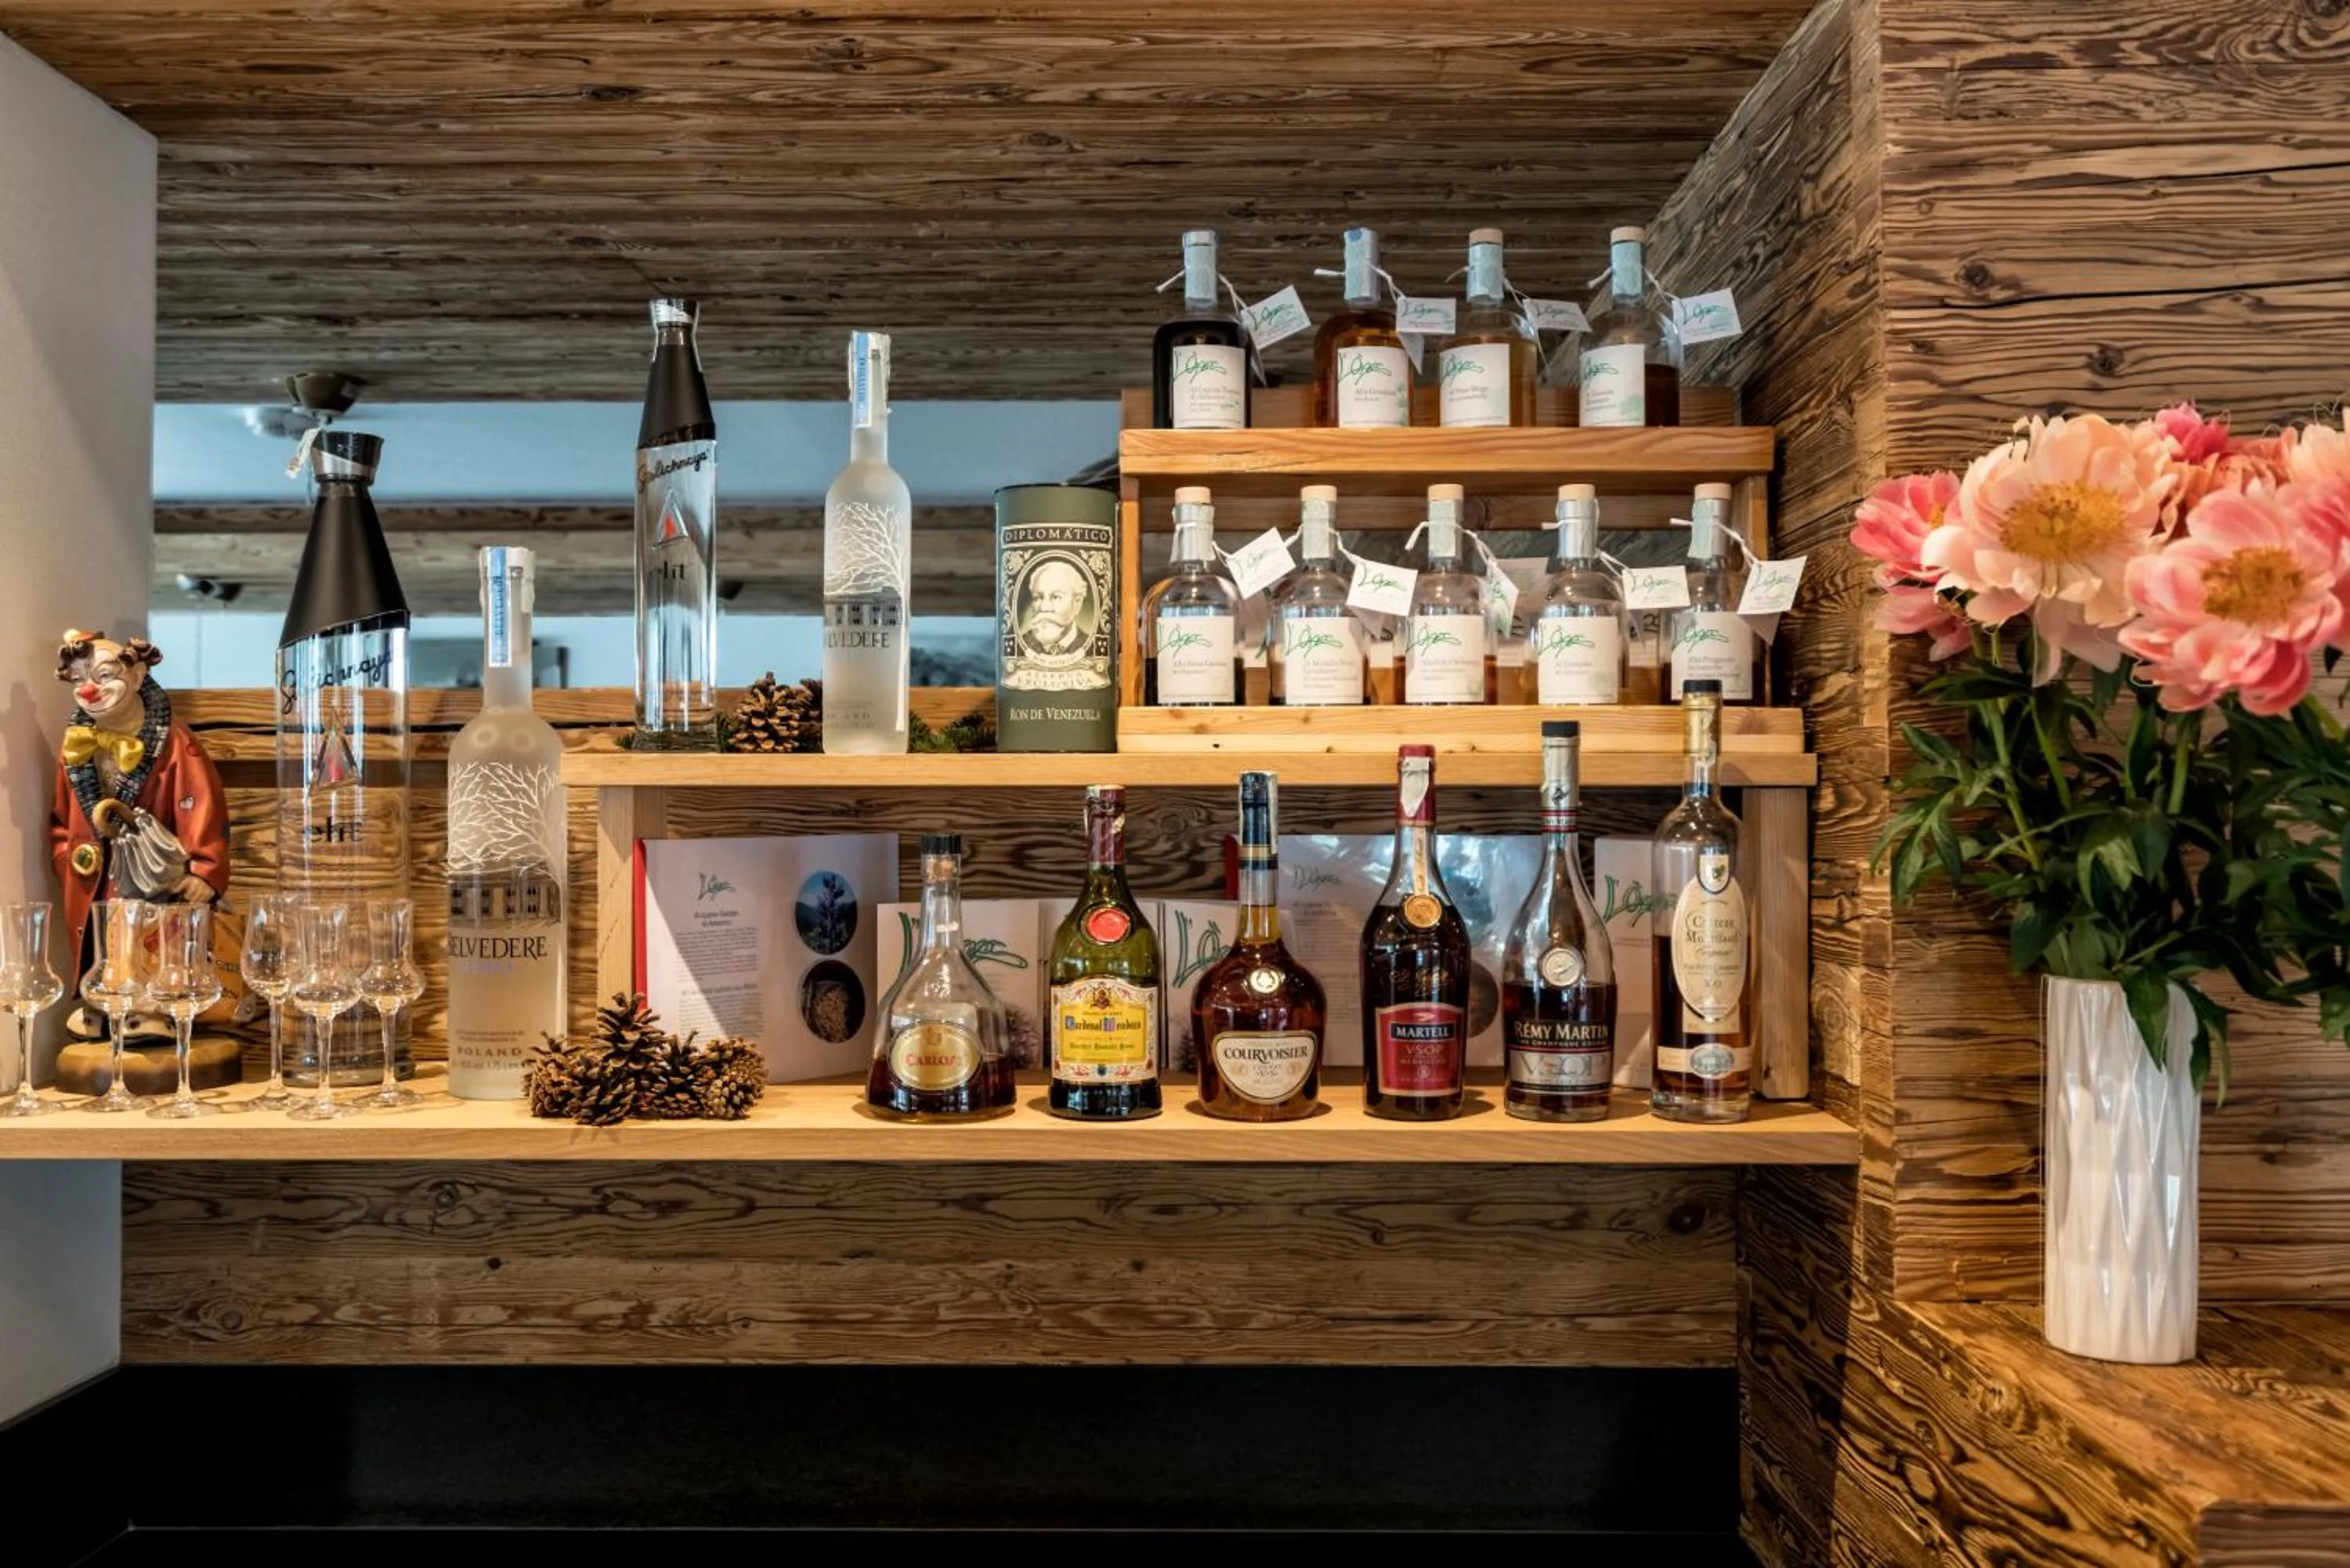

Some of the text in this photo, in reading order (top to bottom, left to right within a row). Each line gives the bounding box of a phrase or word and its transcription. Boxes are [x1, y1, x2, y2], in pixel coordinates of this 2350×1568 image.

[1005, 527, 1108, 541] DIPLOMÁTICO
[1010, 707, 1101, 721] RON DE VENEZUELA
[1395, 1027, 1448, 1038] MARTELL
[1514, 1021, 1609, 1040] RÉMY MARTIN
[457, 1047, 522, 1057] POLAND
[1224, 1046, 1307, 1064] COURVOISIER
